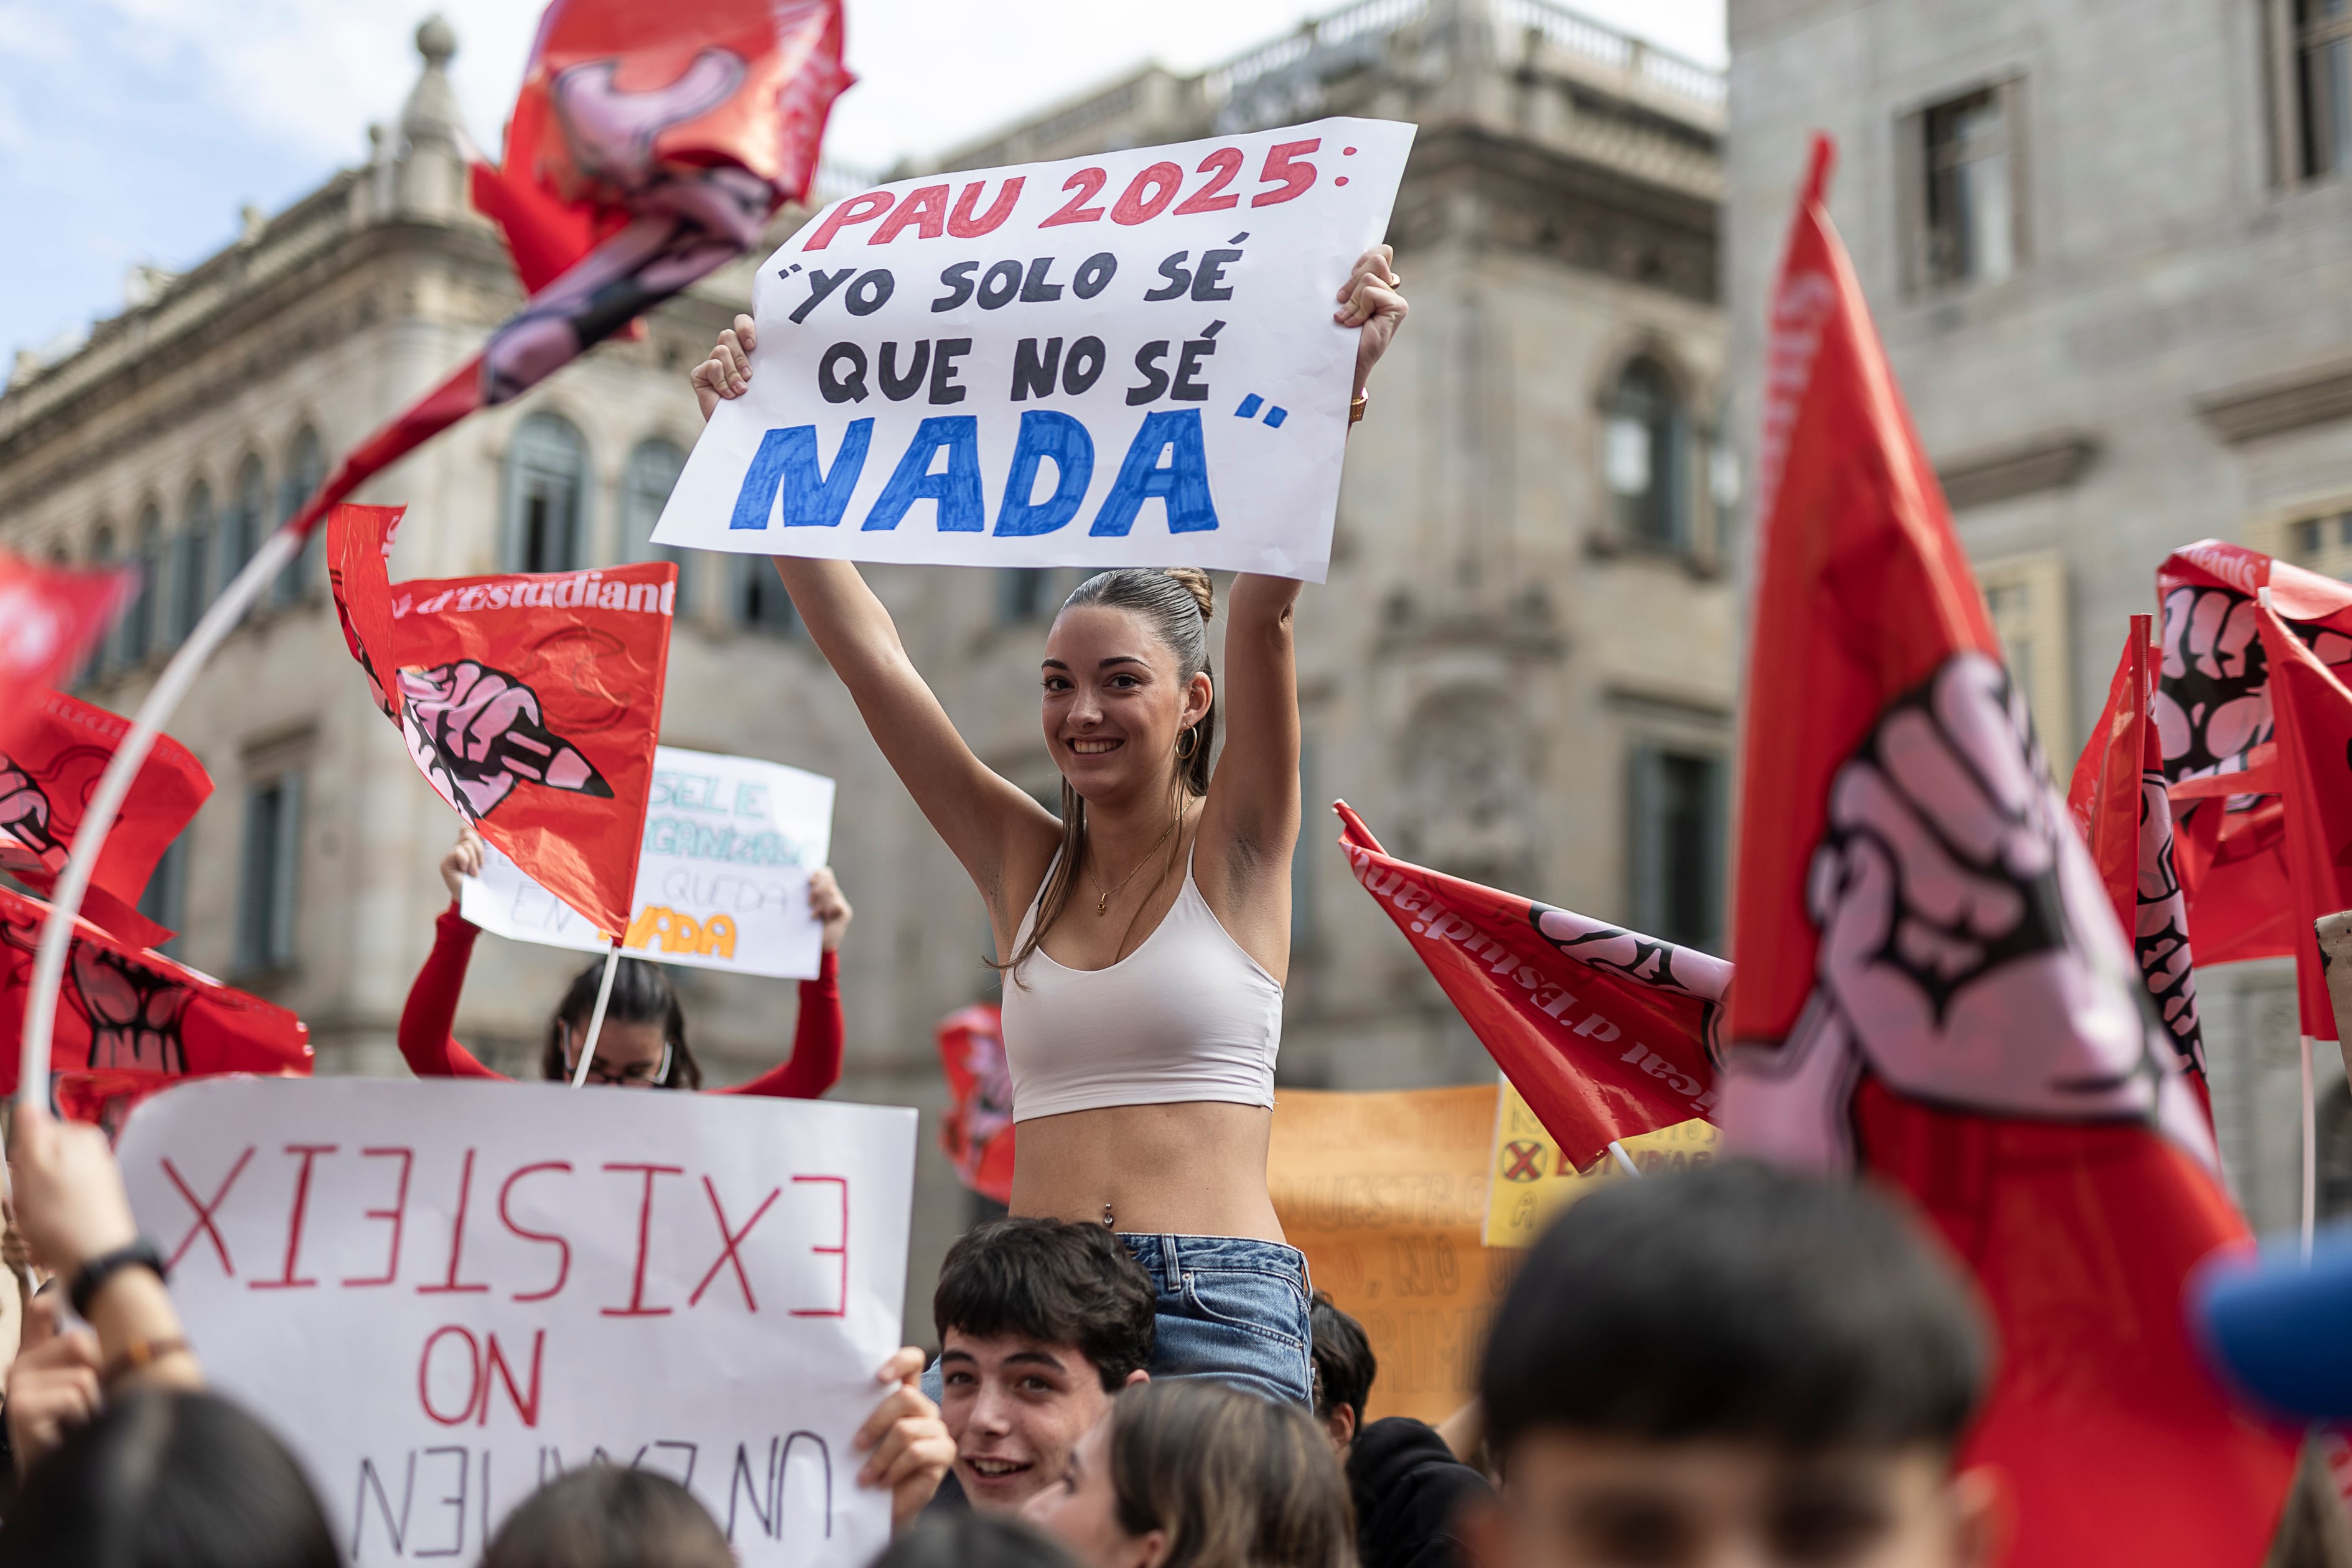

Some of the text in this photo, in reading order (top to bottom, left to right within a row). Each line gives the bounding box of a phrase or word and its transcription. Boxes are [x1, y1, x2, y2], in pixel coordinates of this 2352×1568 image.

[802, 138, 1358, 252] PAU 2025:
[931, 252, 1118, 312] SOLO
[1144, 231, 1250, 302] SÉ
[818, 320, 1227, 406] QUE NO SÉ
[1340, 842, 1621, 1042] d'Estudiant
[161, 1145, 849, 1318] EXISTEIX
[418, 1324, 546, 1429] NO
[726, 1430, 833, 1544] UN
